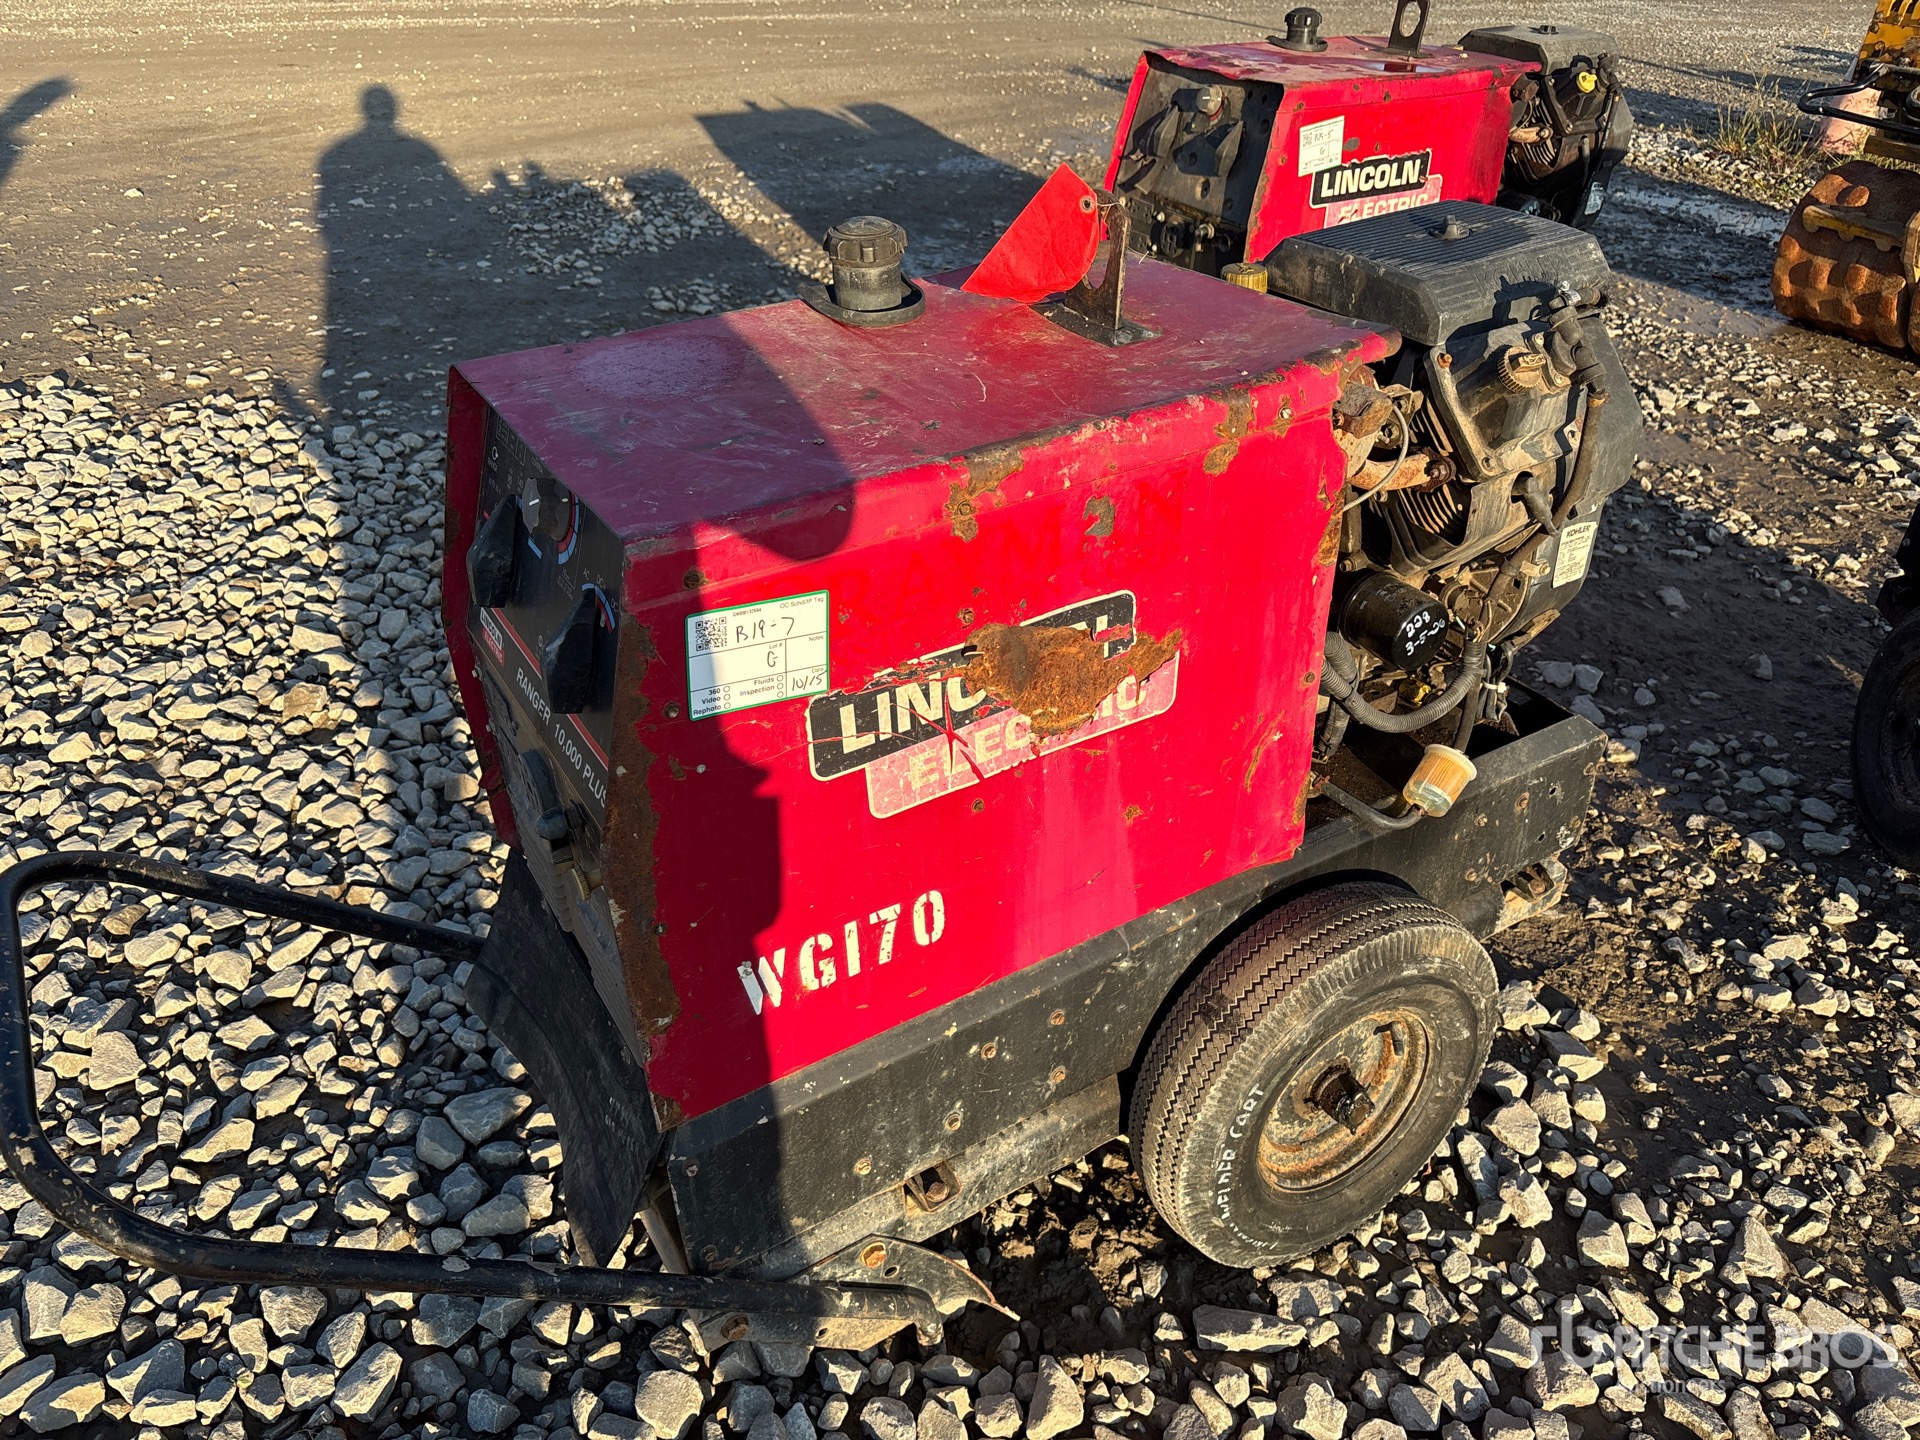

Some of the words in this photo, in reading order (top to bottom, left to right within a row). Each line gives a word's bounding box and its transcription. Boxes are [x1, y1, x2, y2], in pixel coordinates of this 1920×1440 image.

[1321, 159, 1421, 198] LINCOLN
[1566, 525, 1591, 538] KOHLER
[809, 634, 824, 642] Notes
[811, 666, 824, 674] Date
[753, 677, 775, 686] Fluids
[516, 667, 551, 726] RANGER
[708, 688, 721, 696] 360
[739, 685, 775, 697] Inspection
[701, 697, 721, 706] Video
[693, 706, 722, 717] Rephoto
[554, 723, 583, 770] 10,000
[582, 763, 607, 809] PLUS
[737, 889, 946, 1016] WG170
